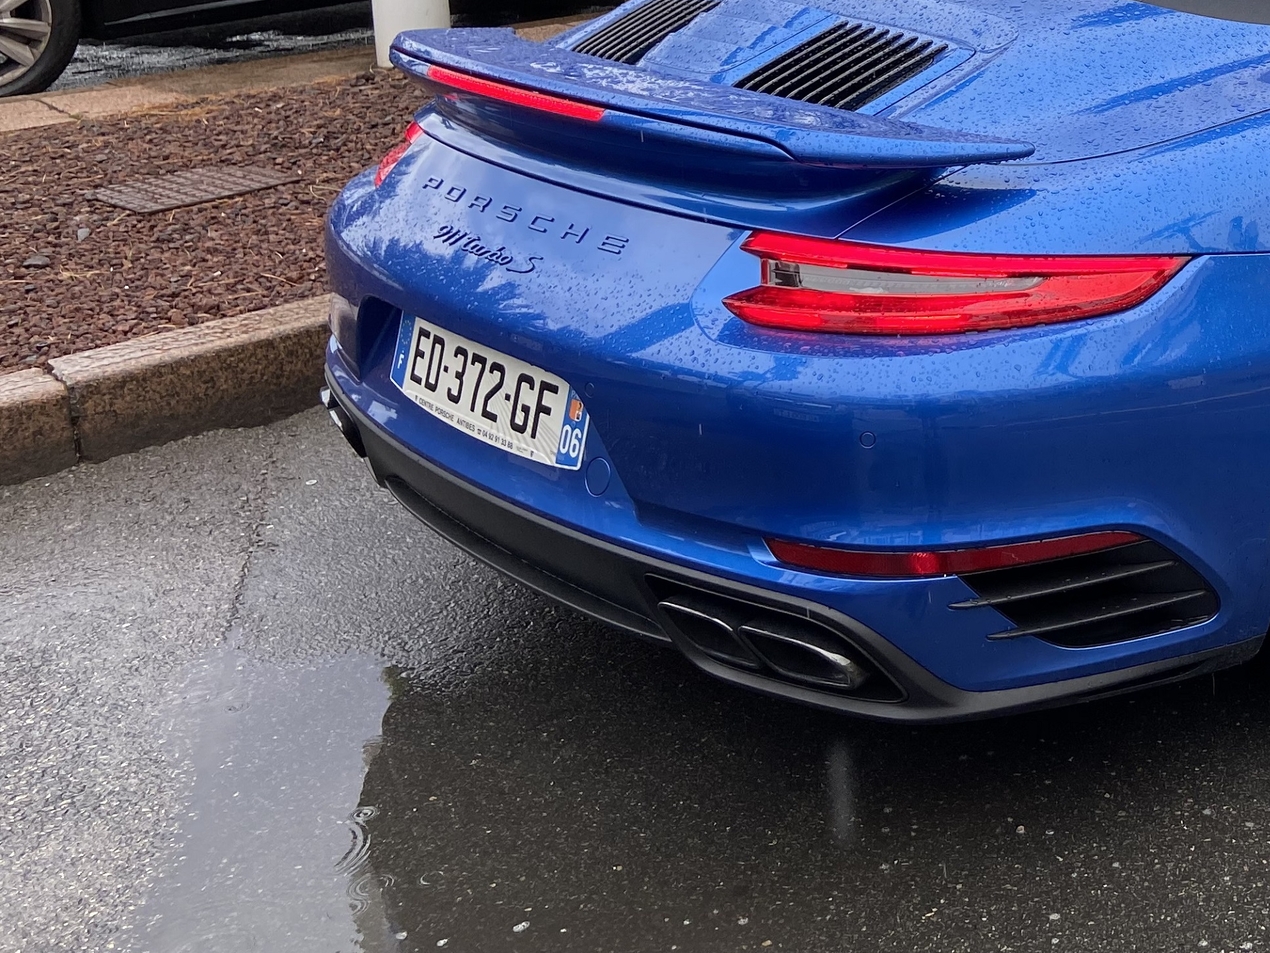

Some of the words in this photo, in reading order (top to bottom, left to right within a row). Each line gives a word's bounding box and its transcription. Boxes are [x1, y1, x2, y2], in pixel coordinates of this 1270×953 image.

[422, 175, 630, 255] PORSCHE
[505, 256, 543, 274] S
[397, 354, 404, 369] F
[410, 326, 560, 440] ED-372-GF
[418, 397, 434, 412] CENTRE
[434, 405, 455, 422] PORSCHE
[456, 418, 475, 432] ANTIBES
[560, 424, 582, 458] 06
